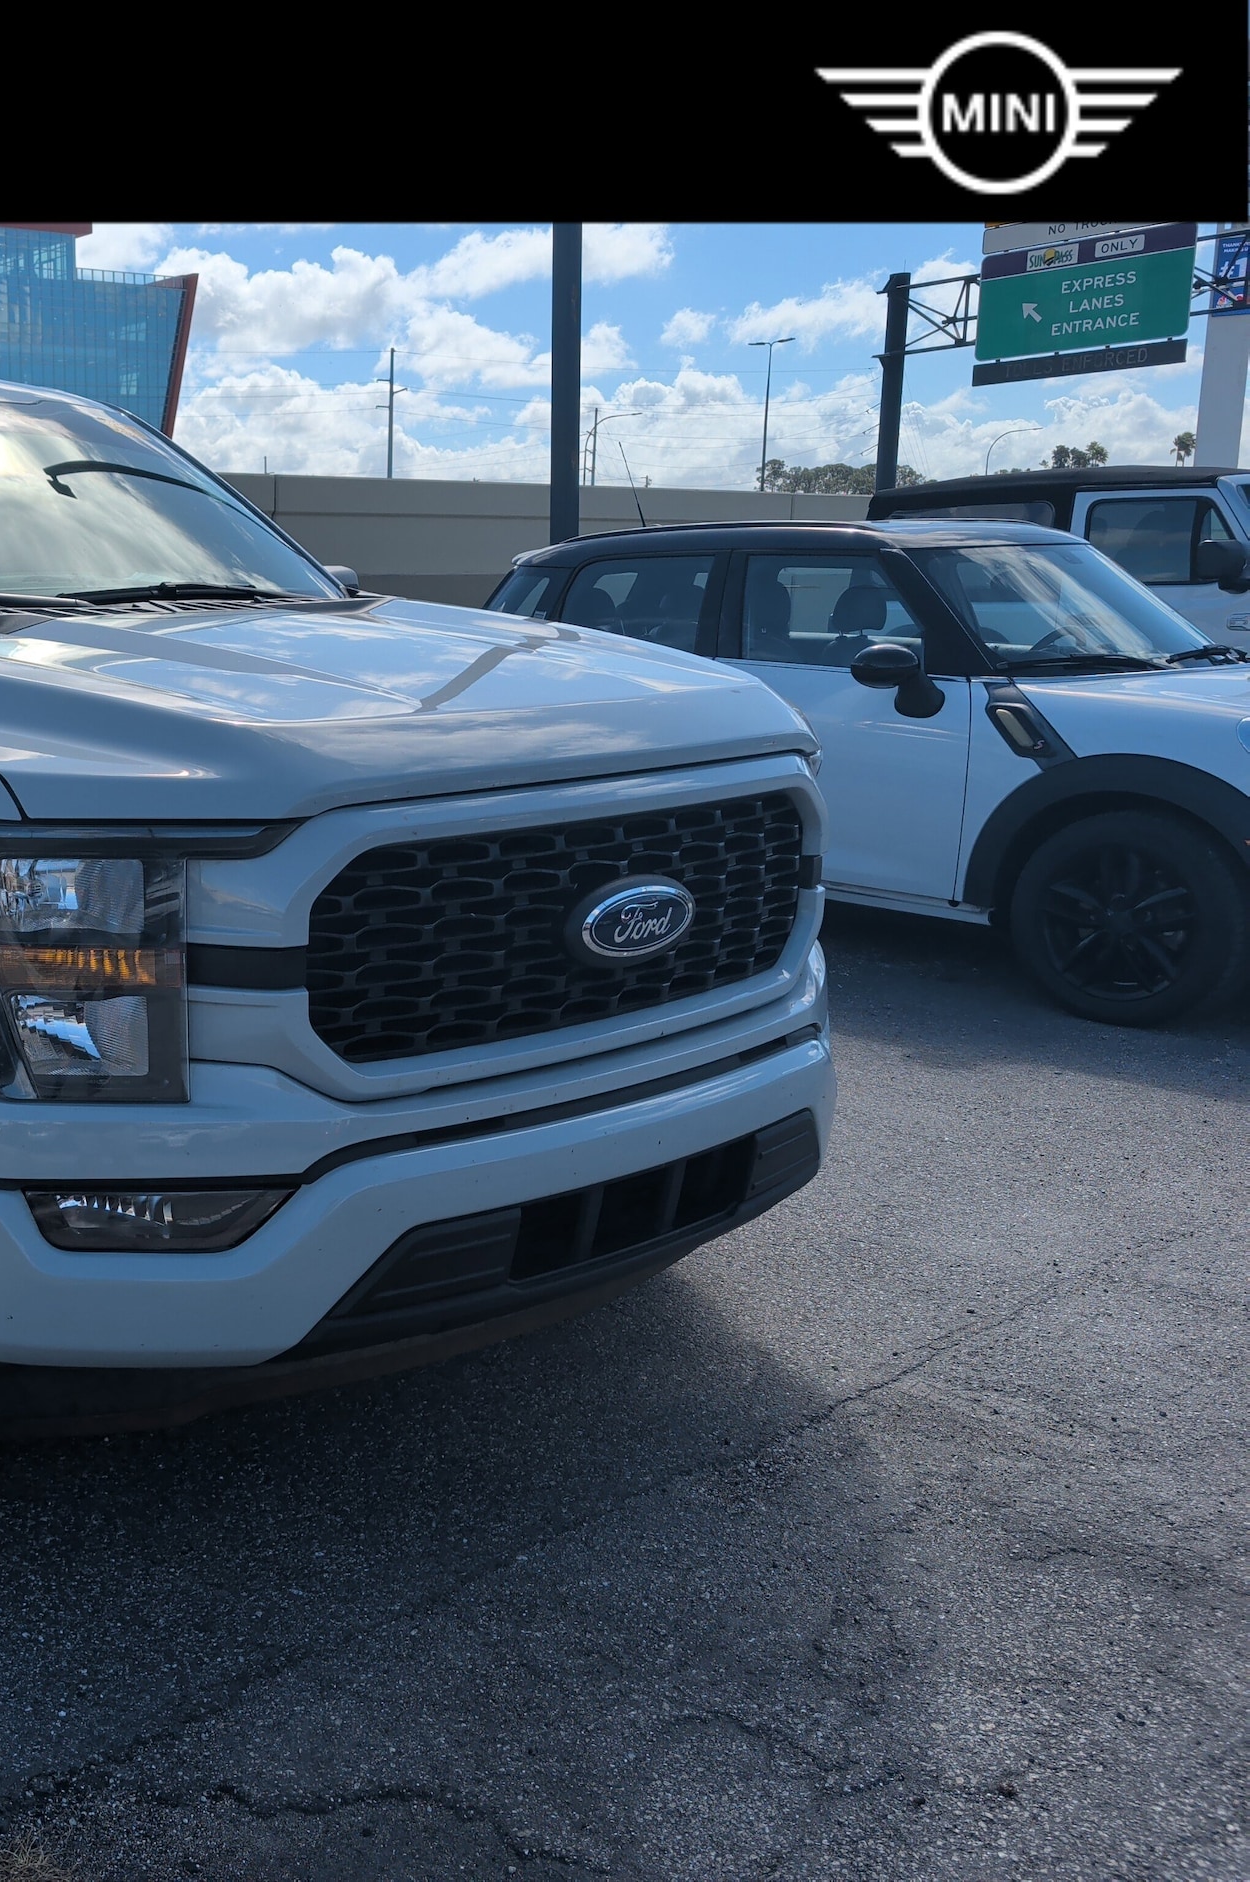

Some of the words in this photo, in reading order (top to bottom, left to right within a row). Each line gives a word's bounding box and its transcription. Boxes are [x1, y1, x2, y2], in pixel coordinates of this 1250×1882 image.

[1048, 223, 1066, 236] NO
[1101, 238, 1138, 254] ONLY
[1061, 270, 1137, 294] EXPRESS
[1069, 294, 1124, 314] LANES
[1050, 312, 1140, 336] ENTRANCE
[1062, 347, 1148, 372] ENFORCED
[614, 901, 673, 943] Ford
